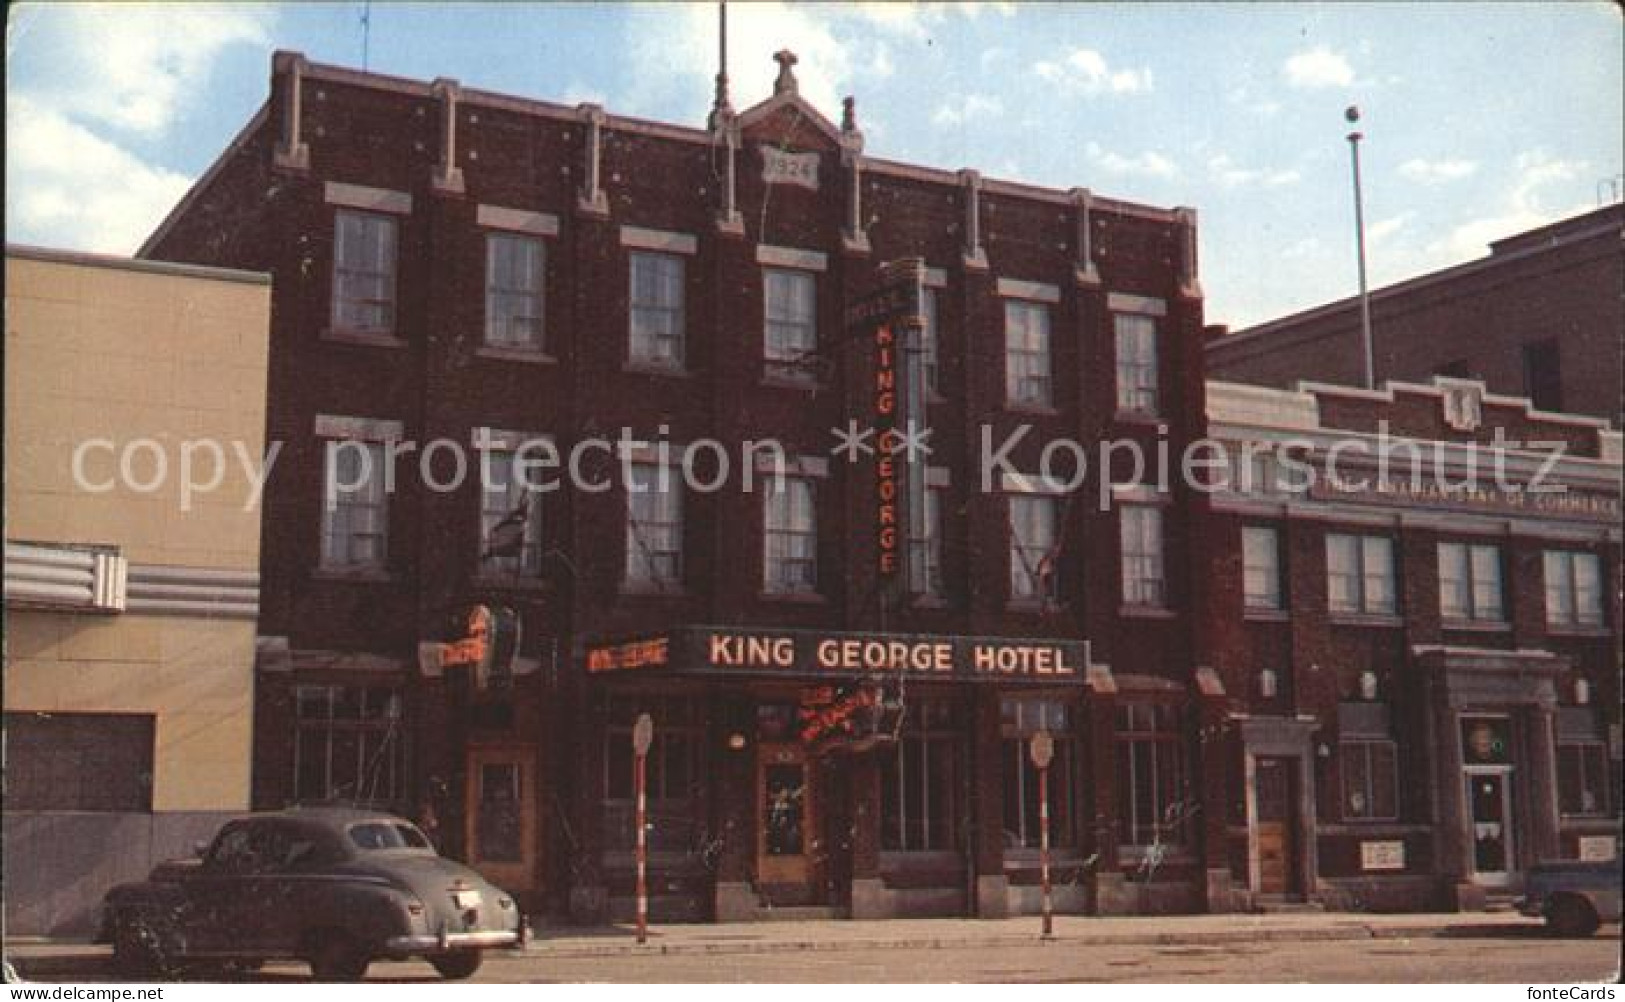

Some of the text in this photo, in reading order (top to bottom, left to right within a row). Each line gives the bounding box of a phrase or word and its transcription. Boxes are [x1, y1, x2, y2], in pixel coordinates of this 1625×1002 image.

[877, 326, 895, 574] KING GEORGE
[710, 635, 1074, 675] KING GEORGE HOTEL
